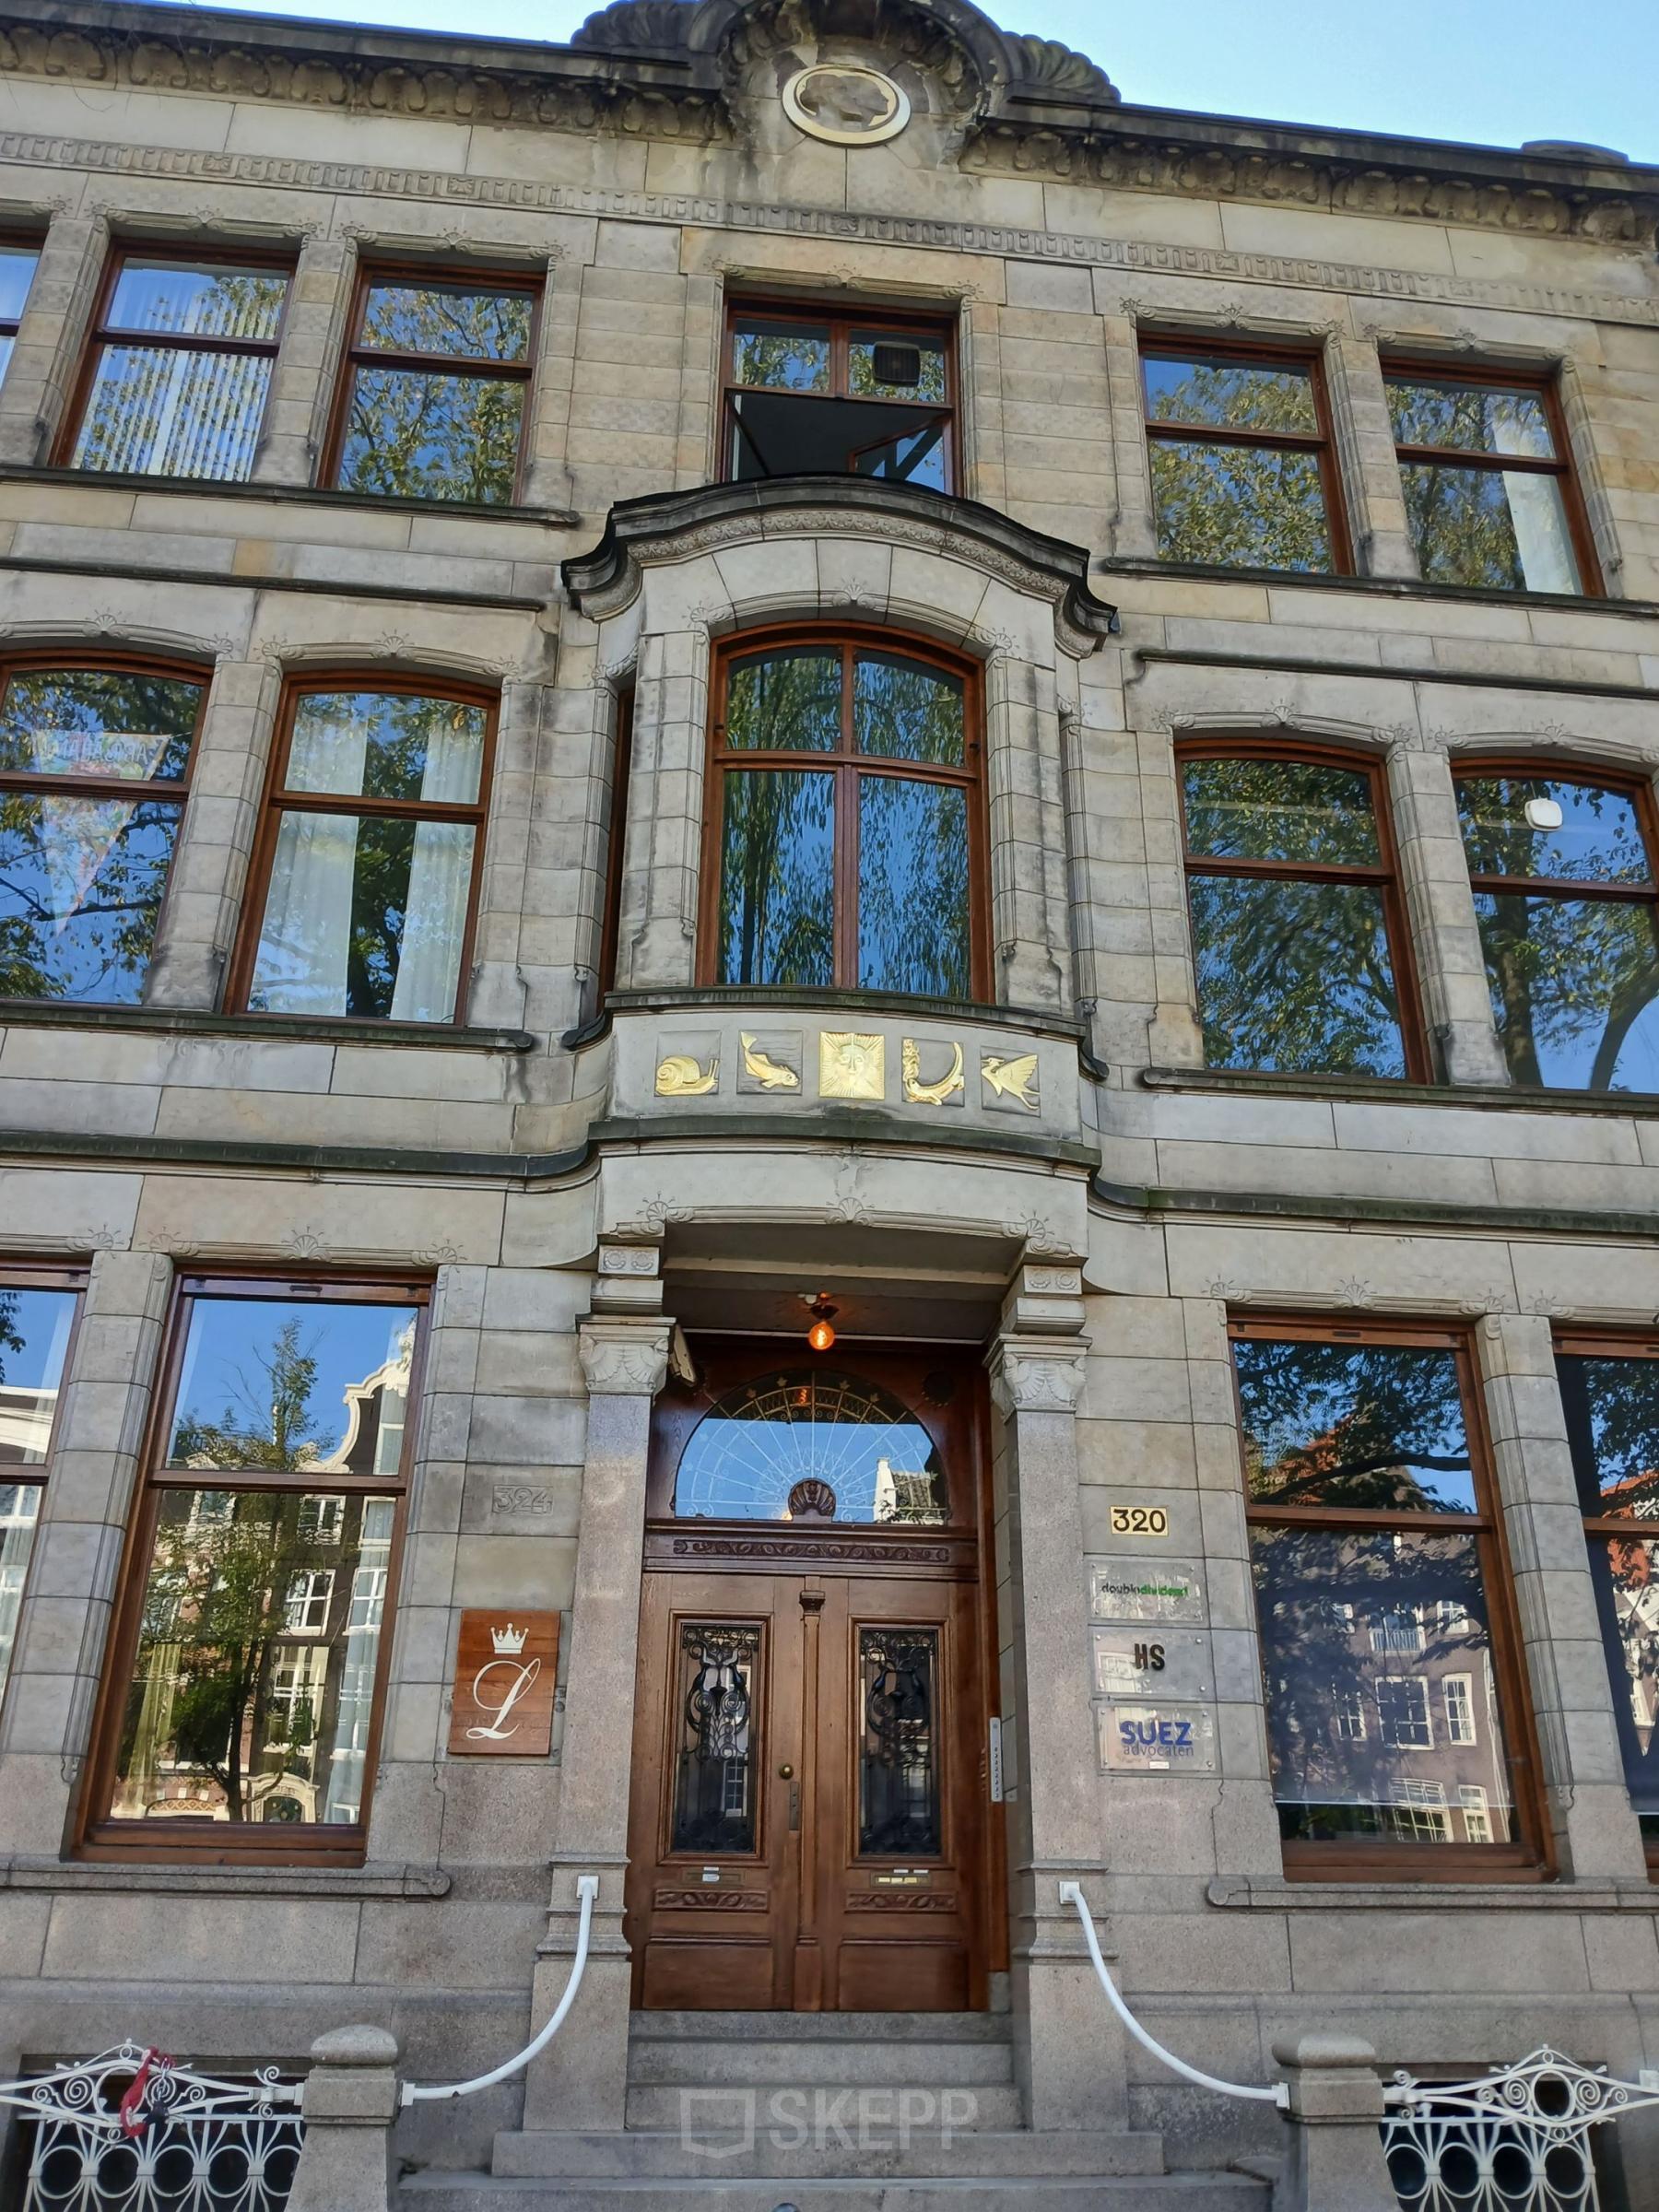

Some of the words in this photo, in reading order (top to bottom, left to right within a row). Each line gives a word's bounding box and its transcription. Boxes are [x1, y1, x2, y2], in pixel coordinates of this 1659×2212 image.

[494, 1487, 552, 1513] 324
[1113, 1508, 1166, 1533] 320
[1135, 1643, 1165, 1671] HS
[1120, 1721, 1193, 1745] SUEZ
[1123, 1742, 1194, 1756] advocaten
